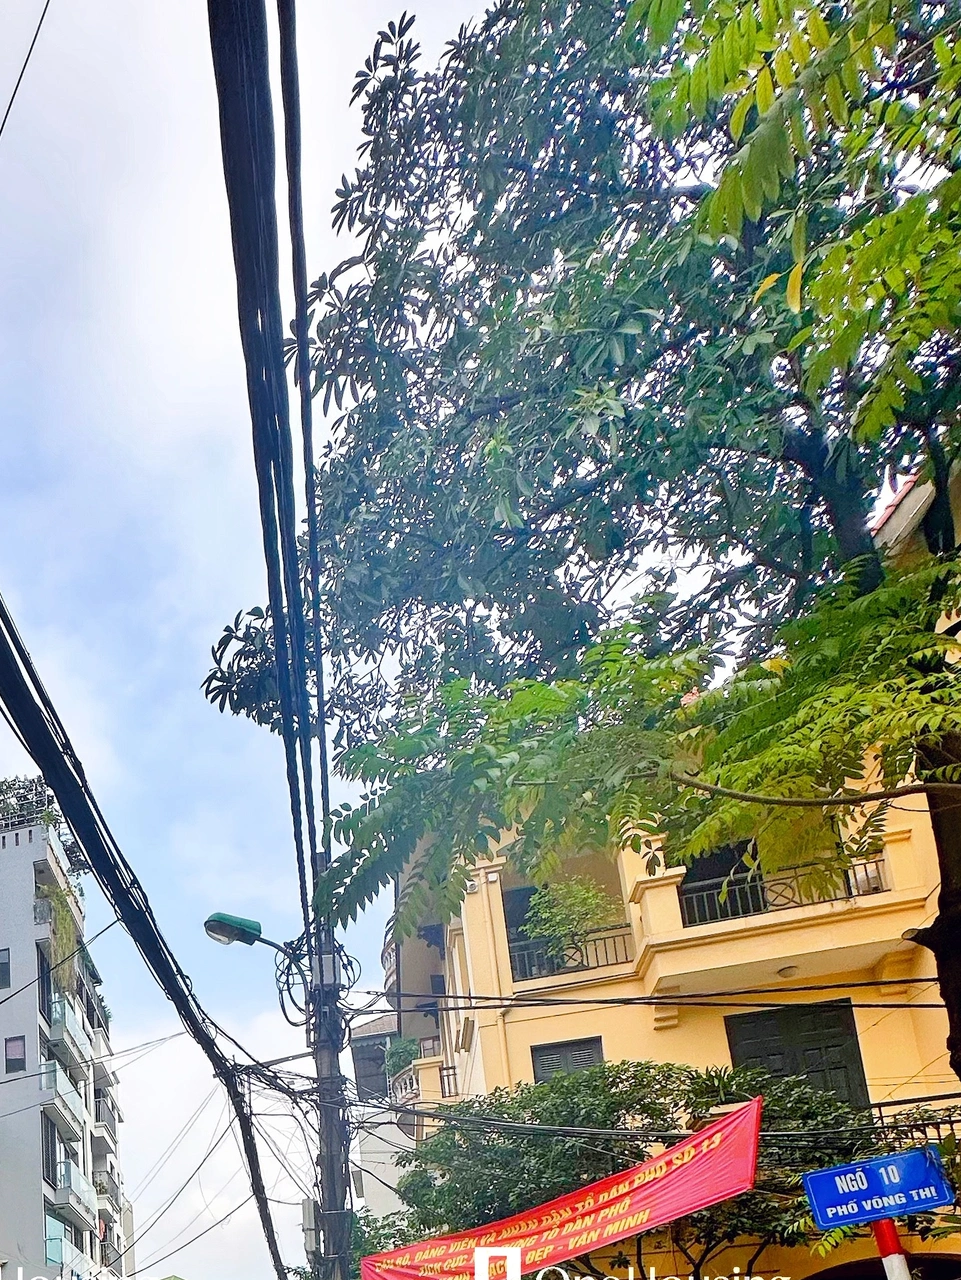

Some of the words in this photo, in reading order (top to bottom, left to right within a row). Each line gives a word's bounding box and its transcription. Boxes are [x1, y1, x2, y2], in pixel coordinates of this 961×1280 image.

[834, 1167, 869, 1195] NGÕ
[878, 1164, 900, 1186] 10
[561, 1213, 596, 1236] DÂN
[596, 1193, 634, 1223] PHỐ
[826, 1198, 859, 1219] PHỐ
[909, 1185, 939, 1200] THỊ
[448, 1236, 477, 1253] VIÊN
[479, 1229, 496, 1246] VÀ
[525, 1244, 555, 1265] ĐẸP
[568, 1227, 602, 1251] VĂN
[603, 1208, 651, 1238] MINH
